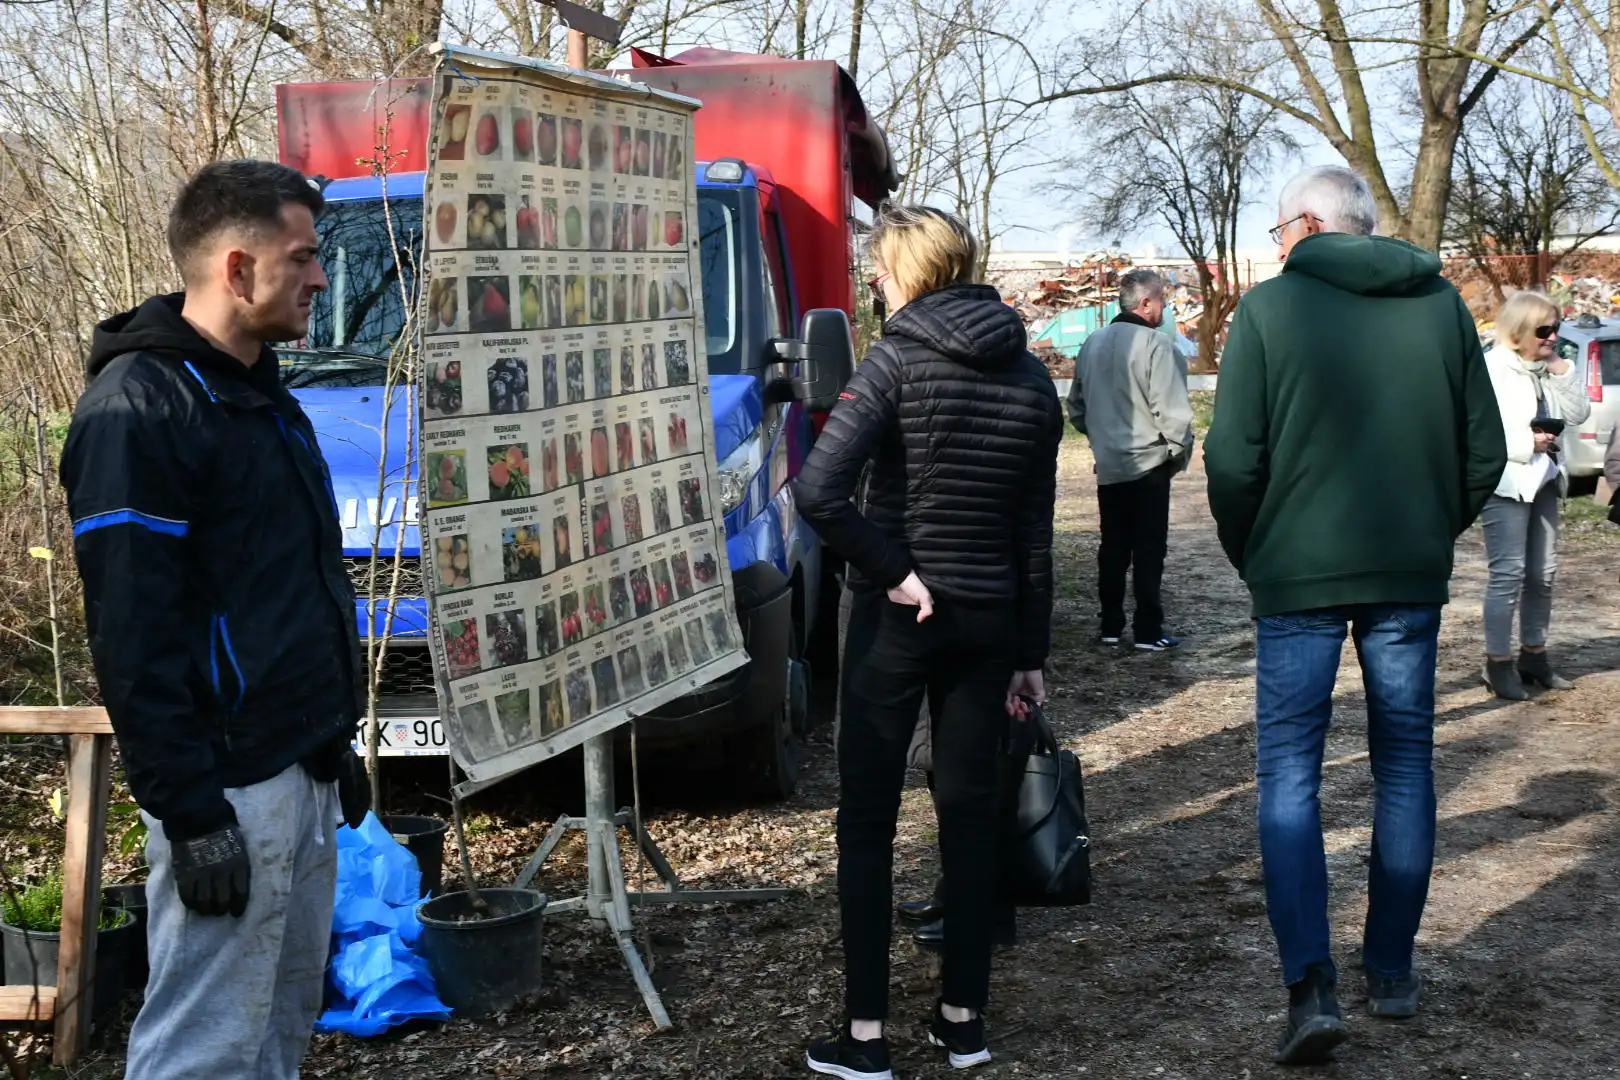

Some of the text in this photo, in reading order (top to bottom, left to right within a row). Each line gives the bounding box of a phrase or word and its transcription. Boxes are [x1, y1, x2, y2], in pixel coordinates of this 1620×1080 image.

[494, 424, 521, 433] REDHAVEN
[440, 429, 466, 439] REDHAVEN
[413, 719, 446, 746] 90
